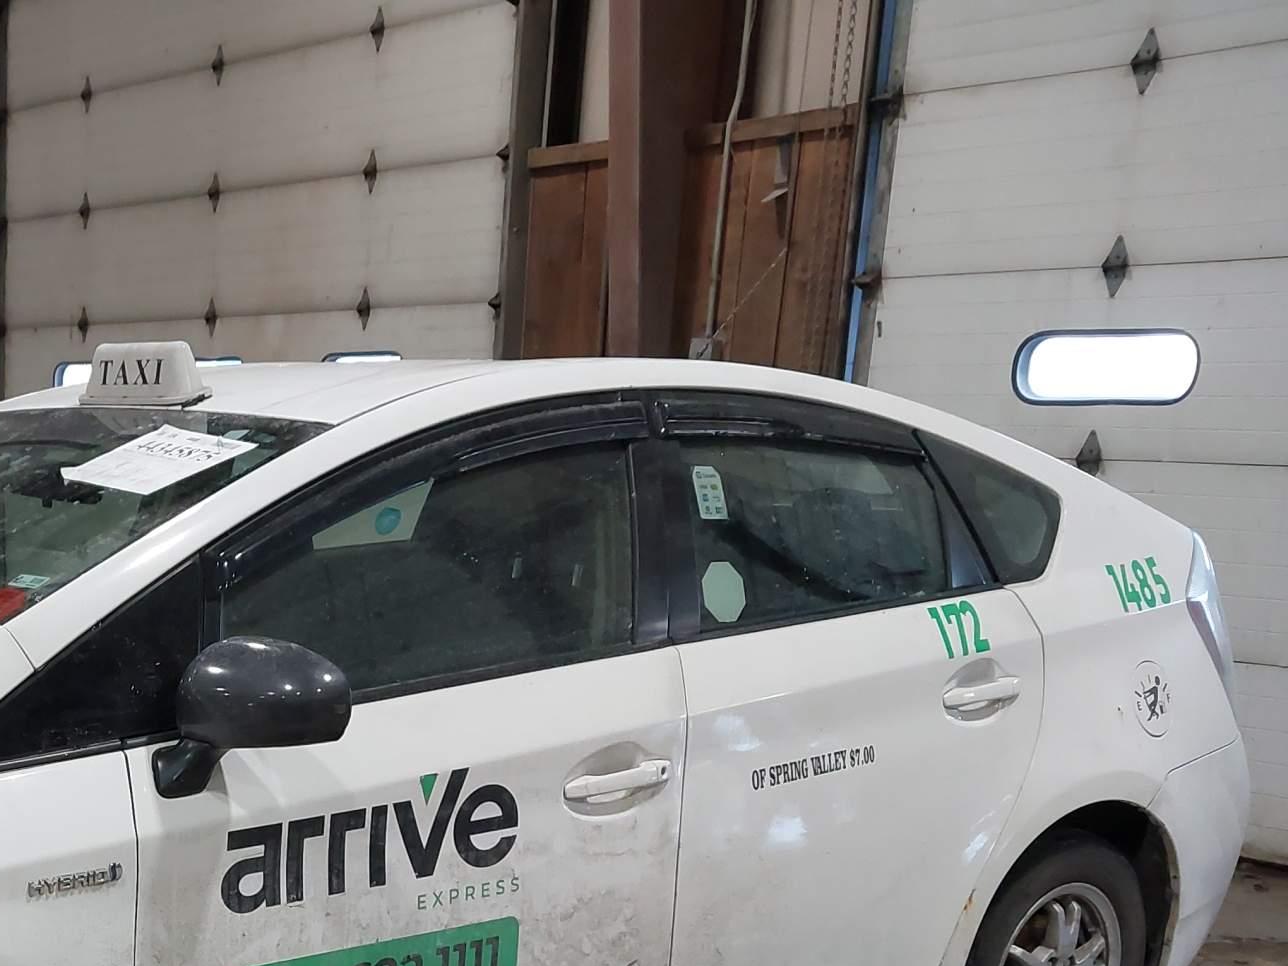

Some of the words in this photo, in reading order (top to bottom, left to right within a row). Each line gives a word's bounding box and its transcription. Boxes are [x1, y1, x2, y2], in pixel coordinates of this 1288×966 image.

[99, 358, 165, 386] TAXI
[1105, 556, 1172, 613] 1485
[927, 600, 991, 659] 172
[751, 768, 767, 791] OF
[769, 759, 809, 787] SPRING
[811, 749, 848, 777] VALLEY
[849, 745, 876, 768] $7.00
[27, 868, 109, 899] HYBRID
[416, 877, 521, 910] EXPRESS
